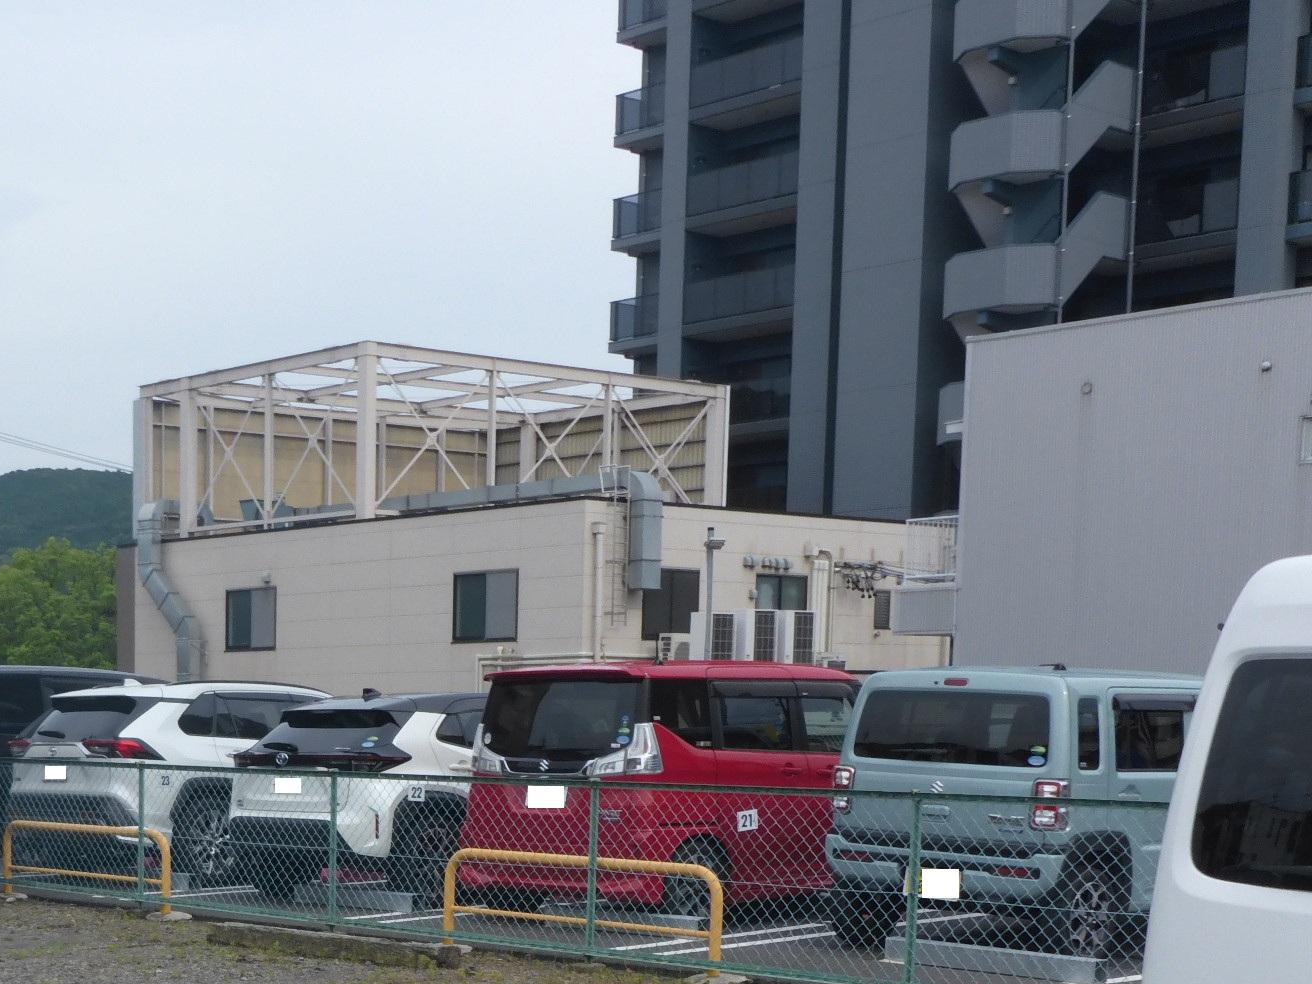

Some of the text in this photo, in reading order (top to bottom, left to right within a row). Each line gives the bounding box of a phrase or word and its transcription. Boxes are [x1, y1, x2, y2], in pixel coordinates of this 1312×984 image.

[161, 775, 170, 786] 23
[411, 786, 423, 798] 22
[740, 813, 753, 828] 21
